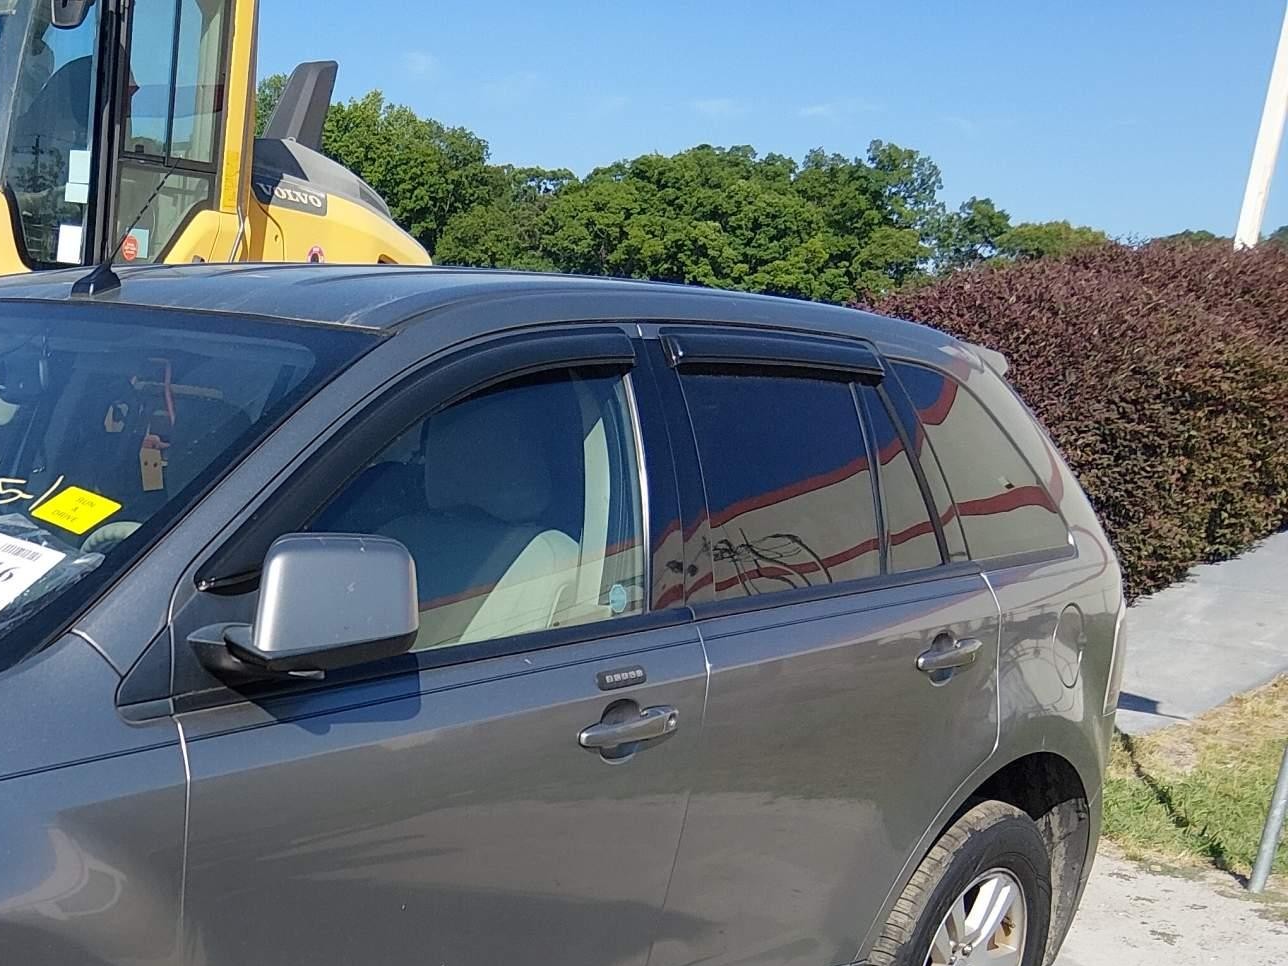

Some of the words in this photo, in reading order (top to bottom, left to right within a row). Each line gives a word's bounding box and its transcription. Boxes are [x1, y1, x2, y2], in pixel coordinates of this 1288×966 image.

[255, 182, 322, 208] VOLVO
[76, 496, 97, 508] RUN
[50, 508, 79, 523] DRIVE
